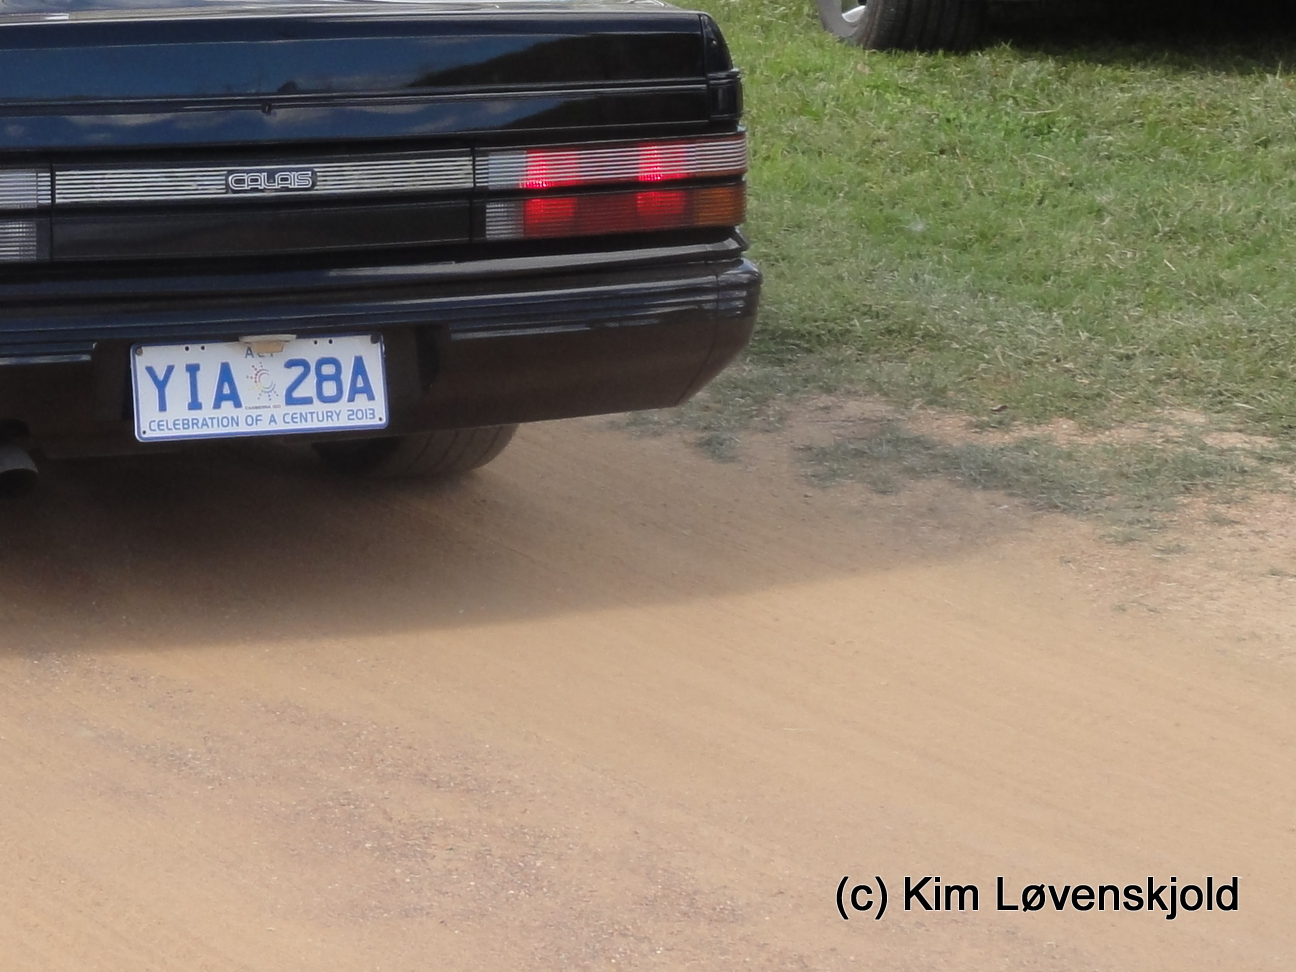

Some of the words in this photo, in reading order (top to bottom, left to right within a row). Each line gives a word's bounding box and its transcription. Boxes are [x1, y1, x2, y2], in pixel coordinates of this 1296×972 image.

[228, 171, 312, 190] CALAIS
[144, 361, 243, 413] YIA
[283, 355, 376, 406] 28A
[148, 415, 240, 432] CELEBRATION
[244, 414, 263, 427] OF
[268, 413, 278, 425] A
[282, 409, 342, 424] CENTURY
[347, 408, 376, 421] 2013
